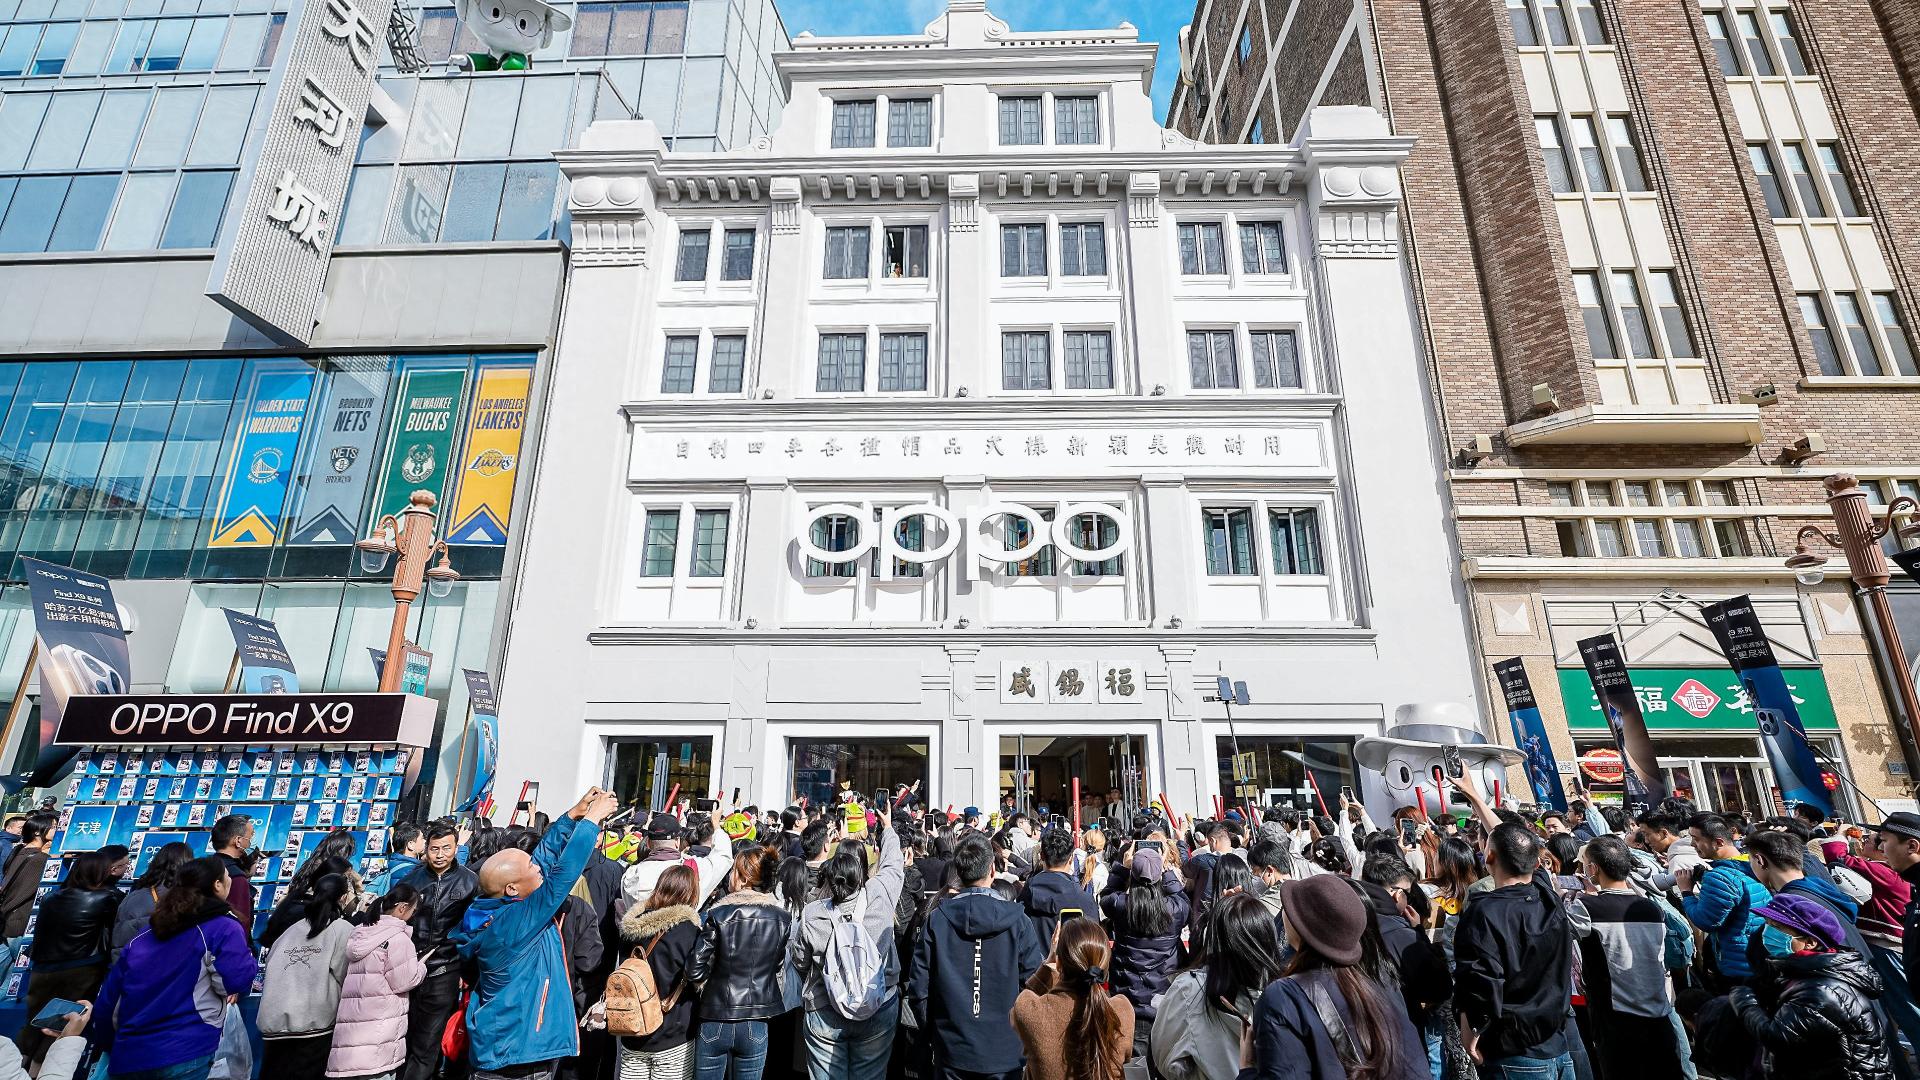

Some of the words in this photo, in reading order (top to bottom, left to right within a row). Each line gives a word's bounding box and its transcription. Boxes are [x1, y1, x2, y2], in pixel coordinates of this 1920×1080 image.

[267, 0, 374, 255] 天河城
[256, 400, 282, 412] GOLDEN
[282, 399, 307, 411] STATE
[338, 398, 374, 409] BROOKLYN
[410, 397, 452, 409] MILWAUKEE
[479, 399, 492, 410] LOS
[493, 399, 525, 410] ANGELES
[249, 416, 302, 433] WARRIORS
[333, 411, 371, 432] NETS
[405, 412, 450, 432] BUCKS
[476, 411, 523, 430] LAKERS
[332, 447, 359, 459] NETS
[1008, 666, 1135, 698] 盛錫福
[110, 703, 217, 735] OPPO
[223, 702, 300, 735] Find
[302, 702, 354, 735] X9
[75, 822, 102, 834] 天津
